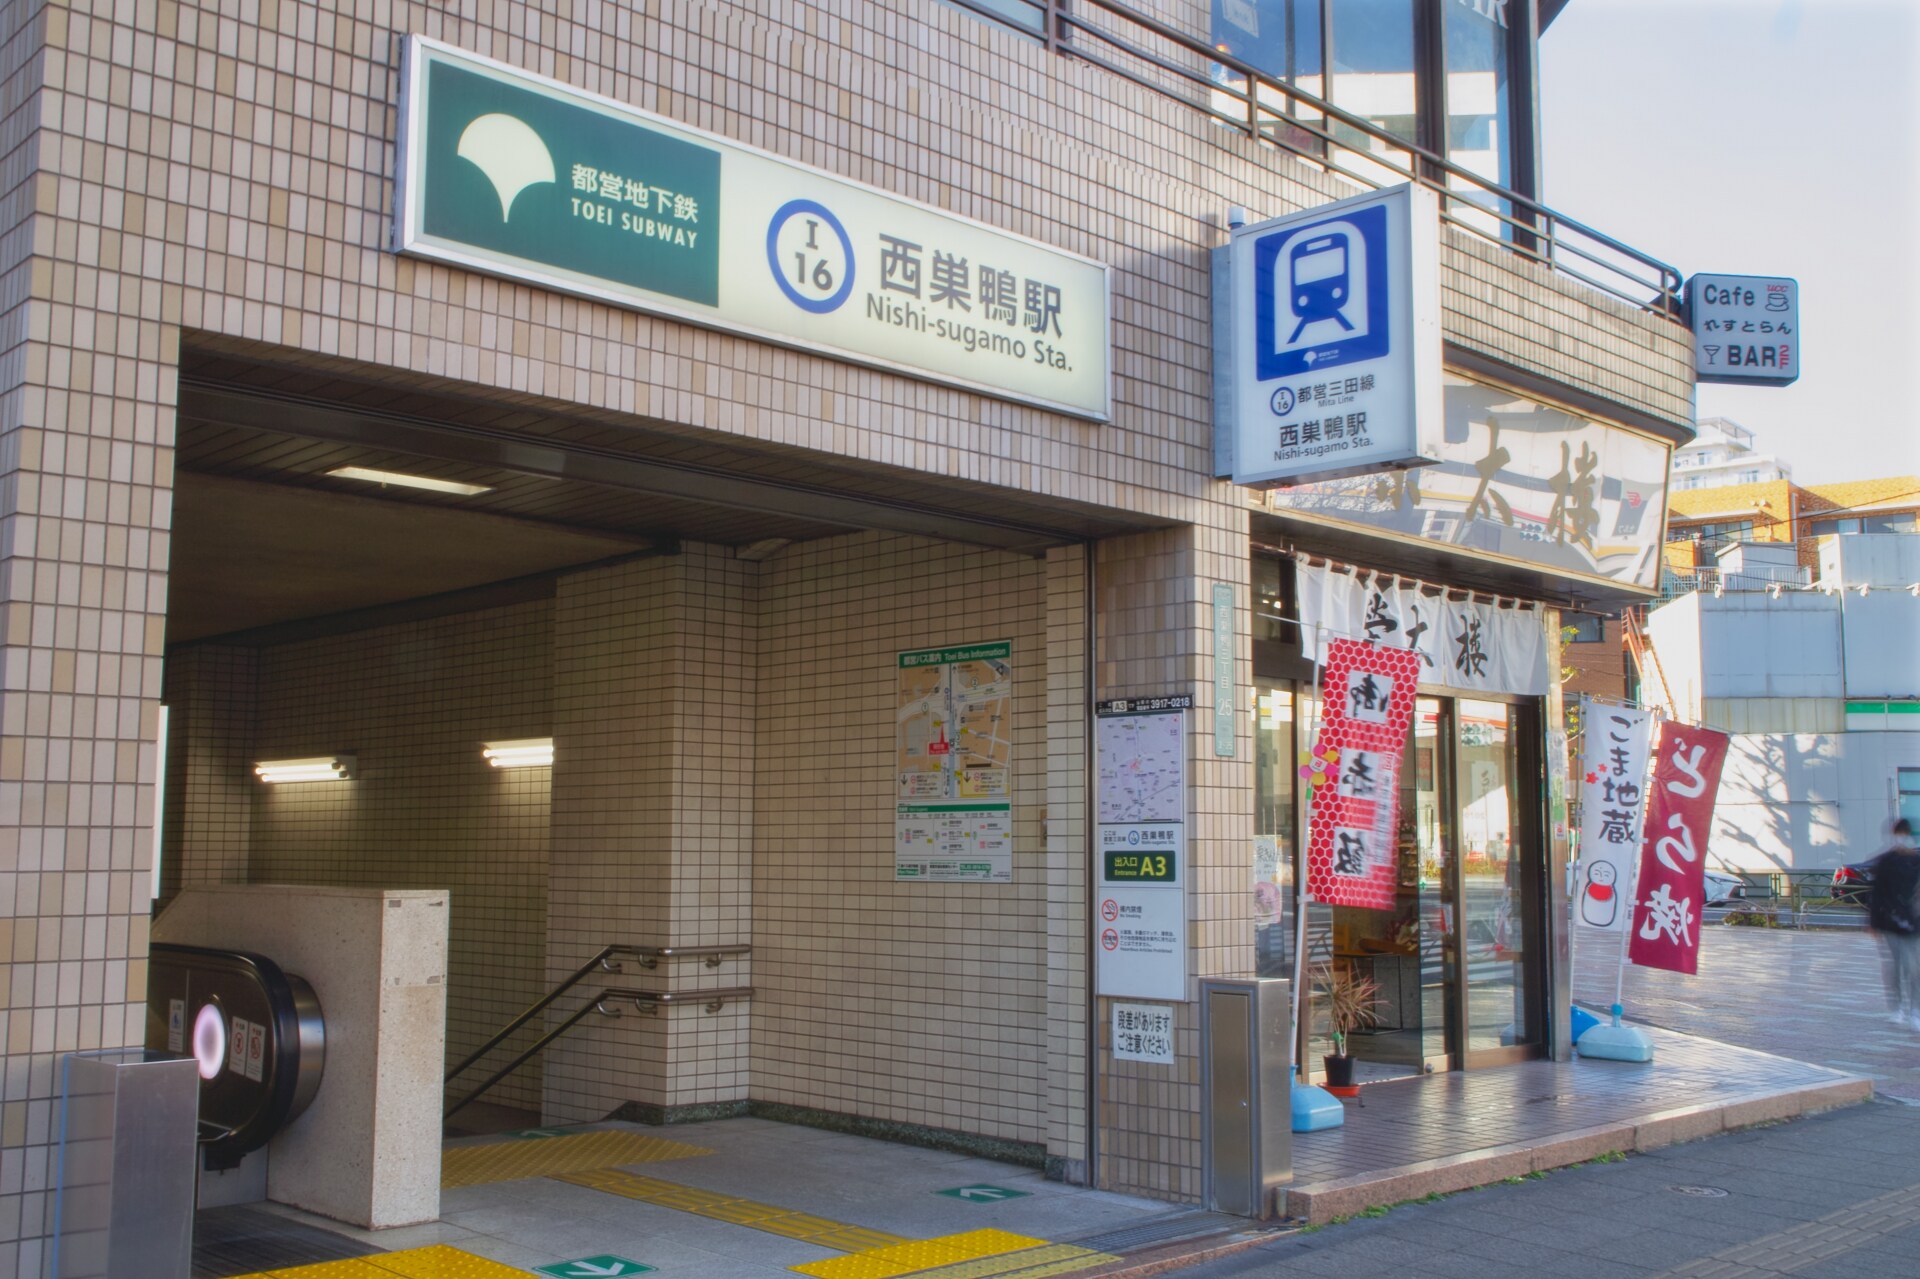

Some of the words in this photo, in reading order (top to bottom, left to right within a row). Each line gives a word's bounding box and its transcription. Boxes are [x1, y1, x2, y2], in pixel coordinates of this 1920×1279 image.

[572, 163, 699, 224] 都営地下鉄
[571, 198, 613, 226] TOEI
[622, 212, 698, 249] SUBWAY
[805, 219, 819, 250] I
[795, 253, 833, 291] 16
[879, 233, 1063, 338] 西巣鴨駅
[1704, 284, 1755, 306] Cafe
[867, 293, 1026, 359] Nishi-sugamo
[1034, 340, 1073, 372] Sta.
[1704, 319, 1792, 335] れすとらん
[1727, 345, 1776, 367] BAR
[1298, 374, 1375, 403] 都営三田線
[1277, 401, 1289, 411] 16
[1318, 399, 1336, 408] Mita
[1338, 395, 1354, 405] Line
[1280, 411, 1368, 448] 西巣鴨駅
[1274, 441, 1349, 462] Nishi-sugamo
[1352, 436, 1374, 448] Sta.
[1150, 697, 1190, 709] 3917-0218
[1218, 698, 1233, 716] 25
[1598, 715, 1644, 845] ごま地蔵
[1114, 857, 1138, 867] 出入口
[1140, 856, 1167, 876] A3
[1118, 1010, 1170, 1033] 段差があります
[1118, 1033, 1171, 1056] ご注意ください
